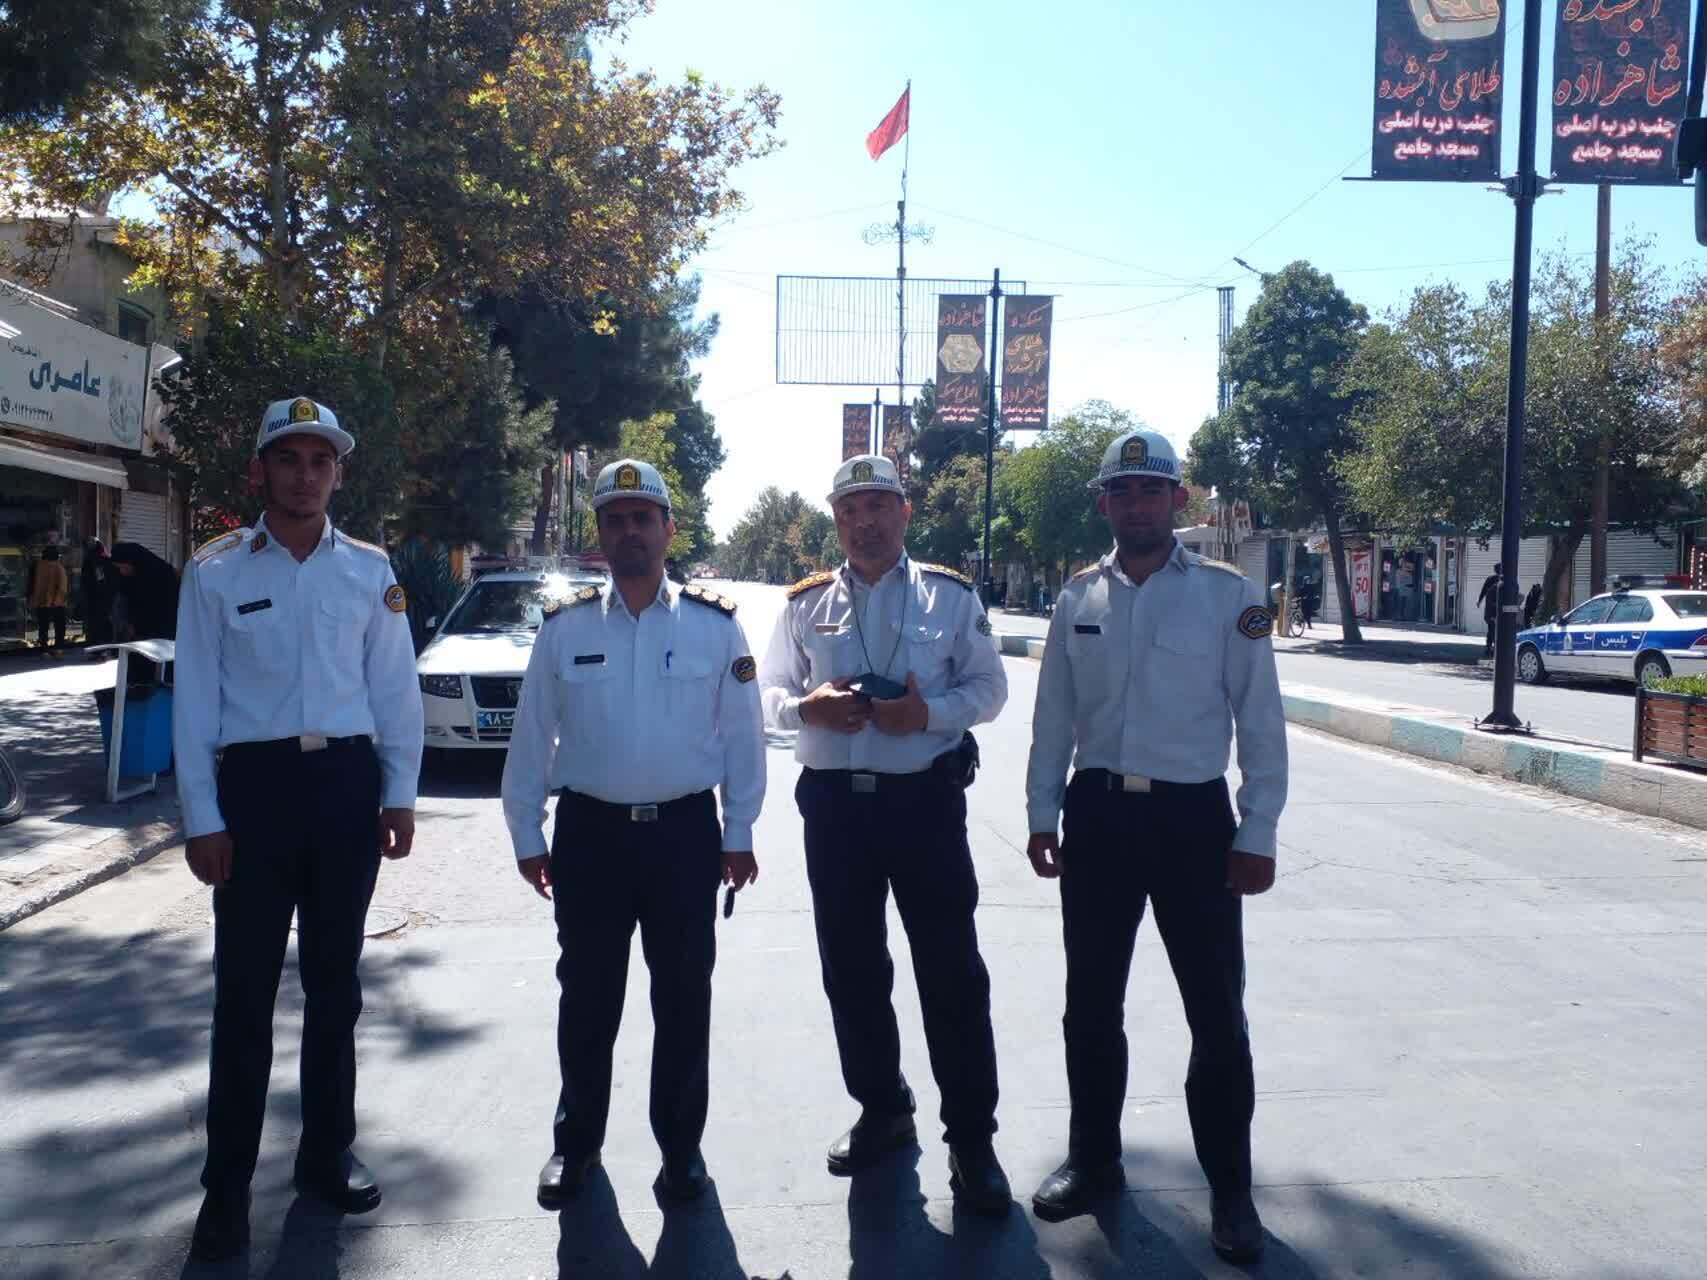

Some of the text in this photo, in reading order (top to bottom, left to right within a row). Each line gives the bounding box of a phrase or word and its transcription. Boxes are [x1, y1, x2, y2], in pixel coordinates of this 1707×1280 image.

[1378, 48, 1448, 107] آبشده
[1554, 41, 1682, 106] شاهزاده
[1378, 110, 1495, 135] جنب درب اصلی
[1556, 113, 1677, 138] جنب درب اصلی
[1394, 137, 1479, 160] مسجد جامع
[1572, 139, 1662, 162] مسجد جامع
[29, 356, 101, 397] عامری
[1355, 577, 1369, 593] 50
[1601, 634, 1628, 648] پلیس
